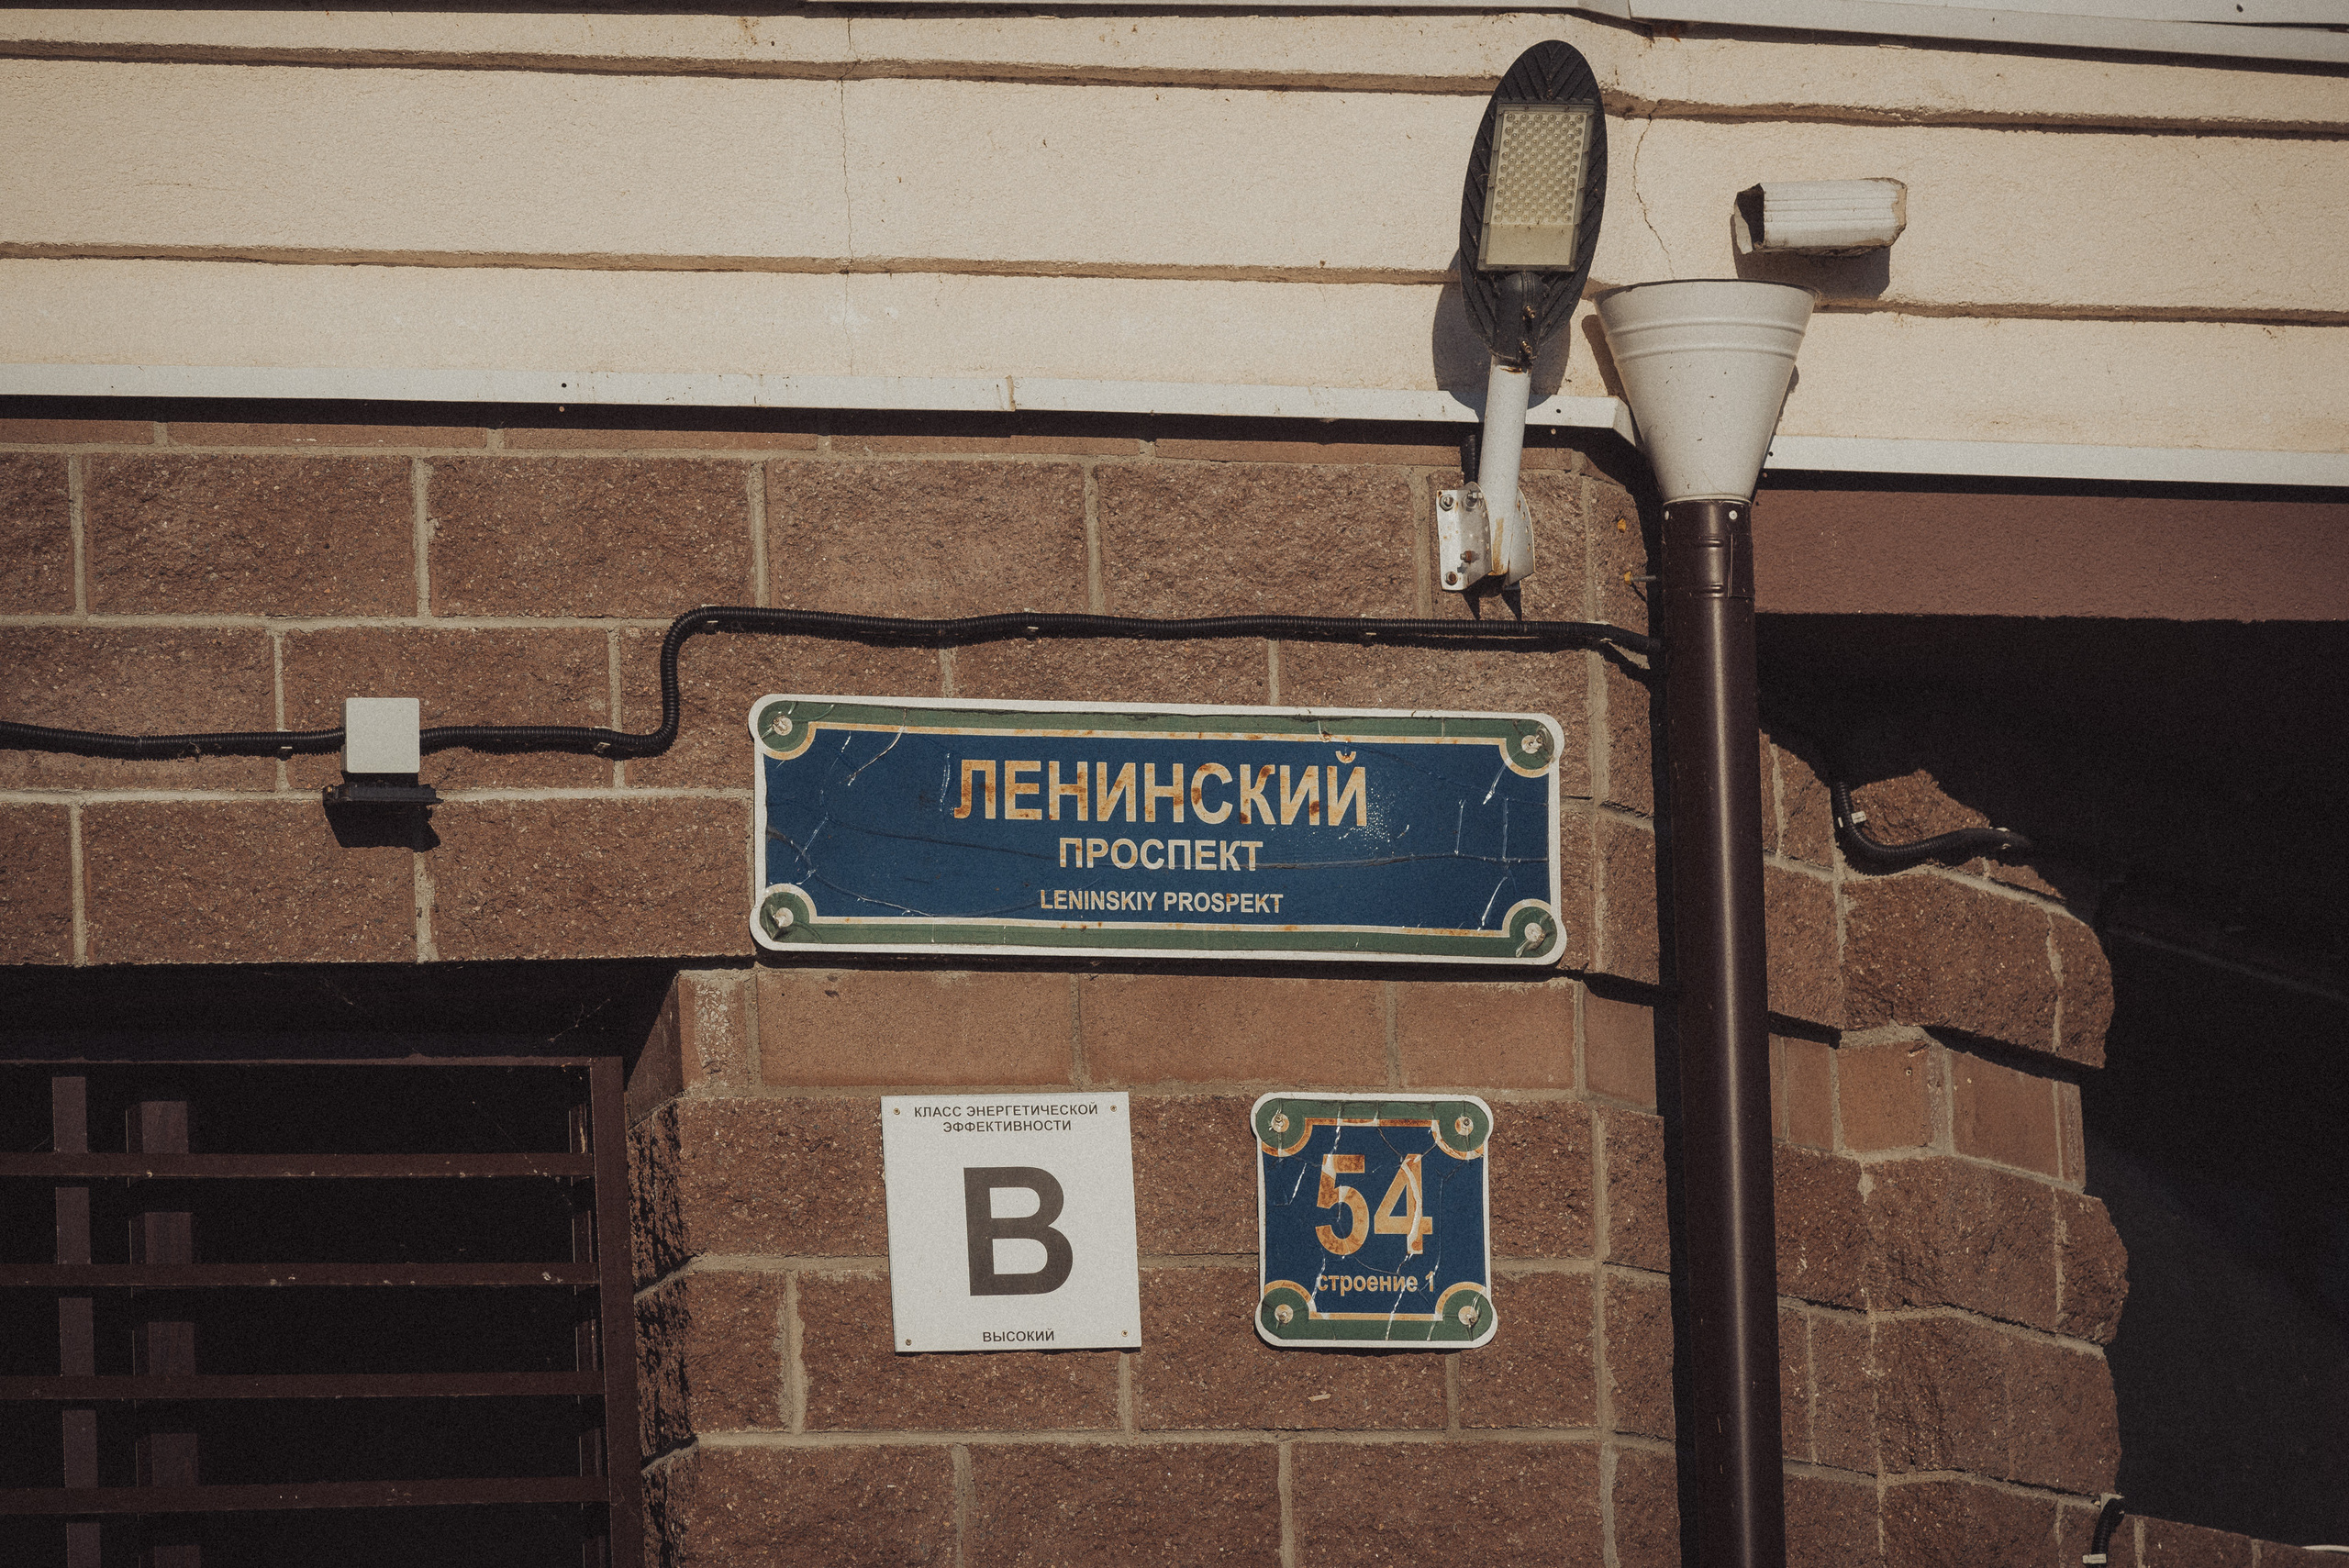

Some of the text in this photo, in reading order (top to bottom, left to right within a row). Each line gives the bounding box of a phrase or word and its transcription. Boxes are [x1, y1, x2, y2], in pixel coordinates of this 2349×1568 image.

[953, 751, 1368, 828] ЛЕНИНСКИЙ
[1059, 837, 1264, 873] ПРОСПЕКТ
[1040, 889, 1285, 915] LENINSKIY PROSPEKT
[914, 1101, 1099, 1118] КЛАСС ЭНЕРГЕТИЧЕСКОЙ
[942, 1119, 1072, 1133] ЭФФЕКТИВНОСТИ
[1315, 1153, 1433, 1256] 54
[1318, 1271, 1435, 1296] строение 1
[982, 1328, 1055, 1342] ВЫСОКИЙ
